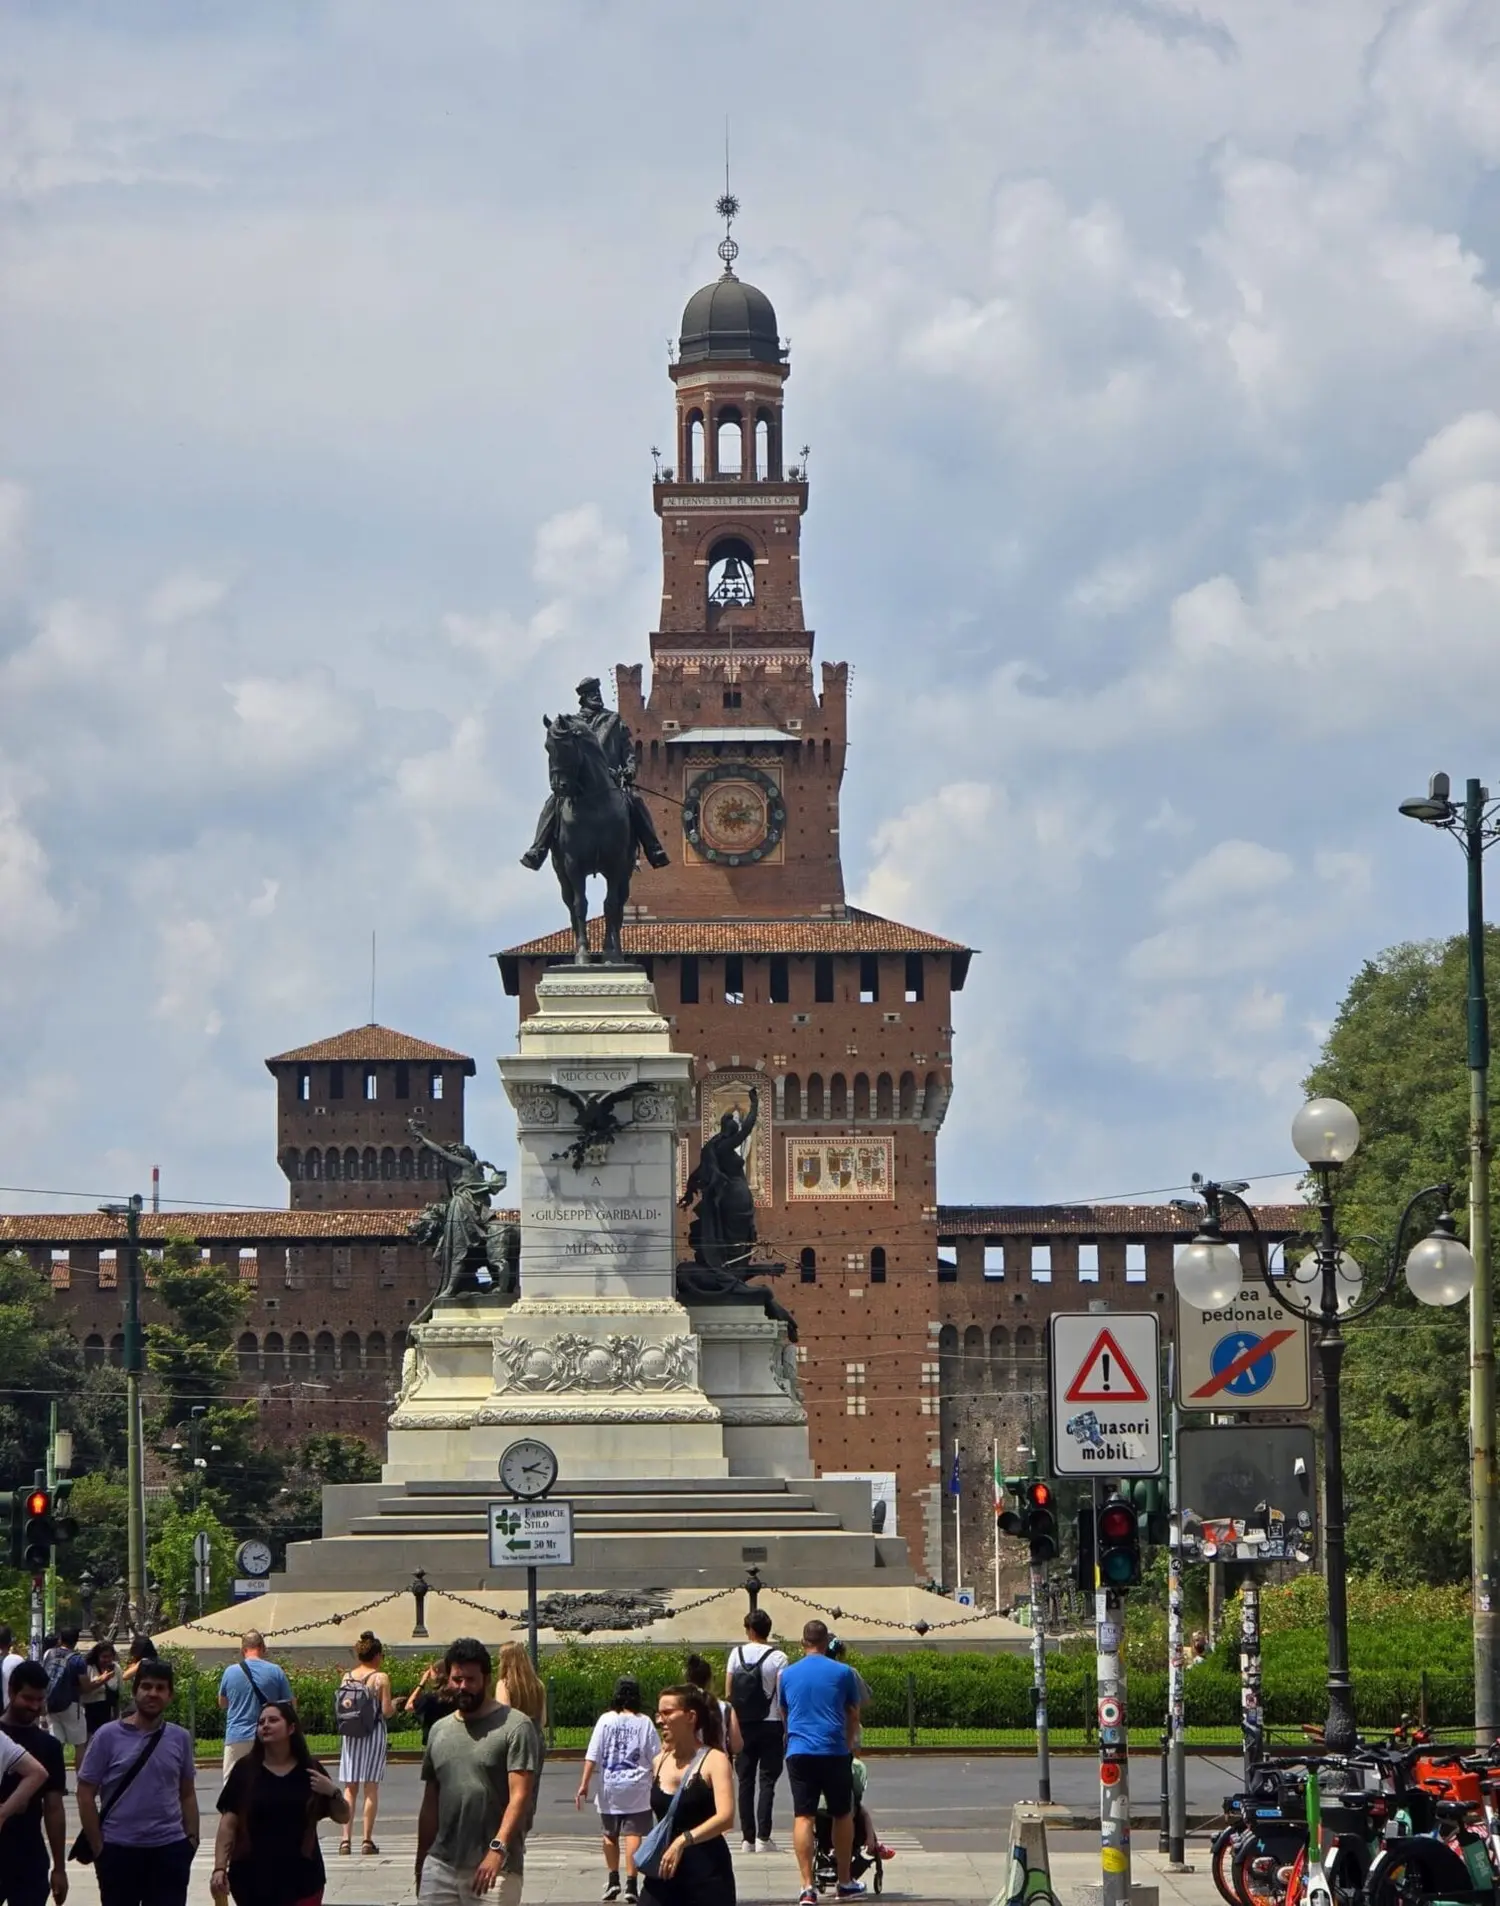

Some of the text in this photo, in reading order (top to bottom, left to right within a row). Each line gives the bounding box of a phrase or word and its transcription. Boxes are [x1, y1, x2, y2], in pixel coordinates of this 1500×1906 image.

[561, 1071, 630, 1082] MDCCCXCIV
[590, 1176, 602, 1187] A
[596, 1209, 657, 1221] GARIBALDI
[564, 1243, 628, 1254] MILANO
[1202, 1307, 1284, 1325] pedonale
[1066, 1418, 1150, 1435] uasori
